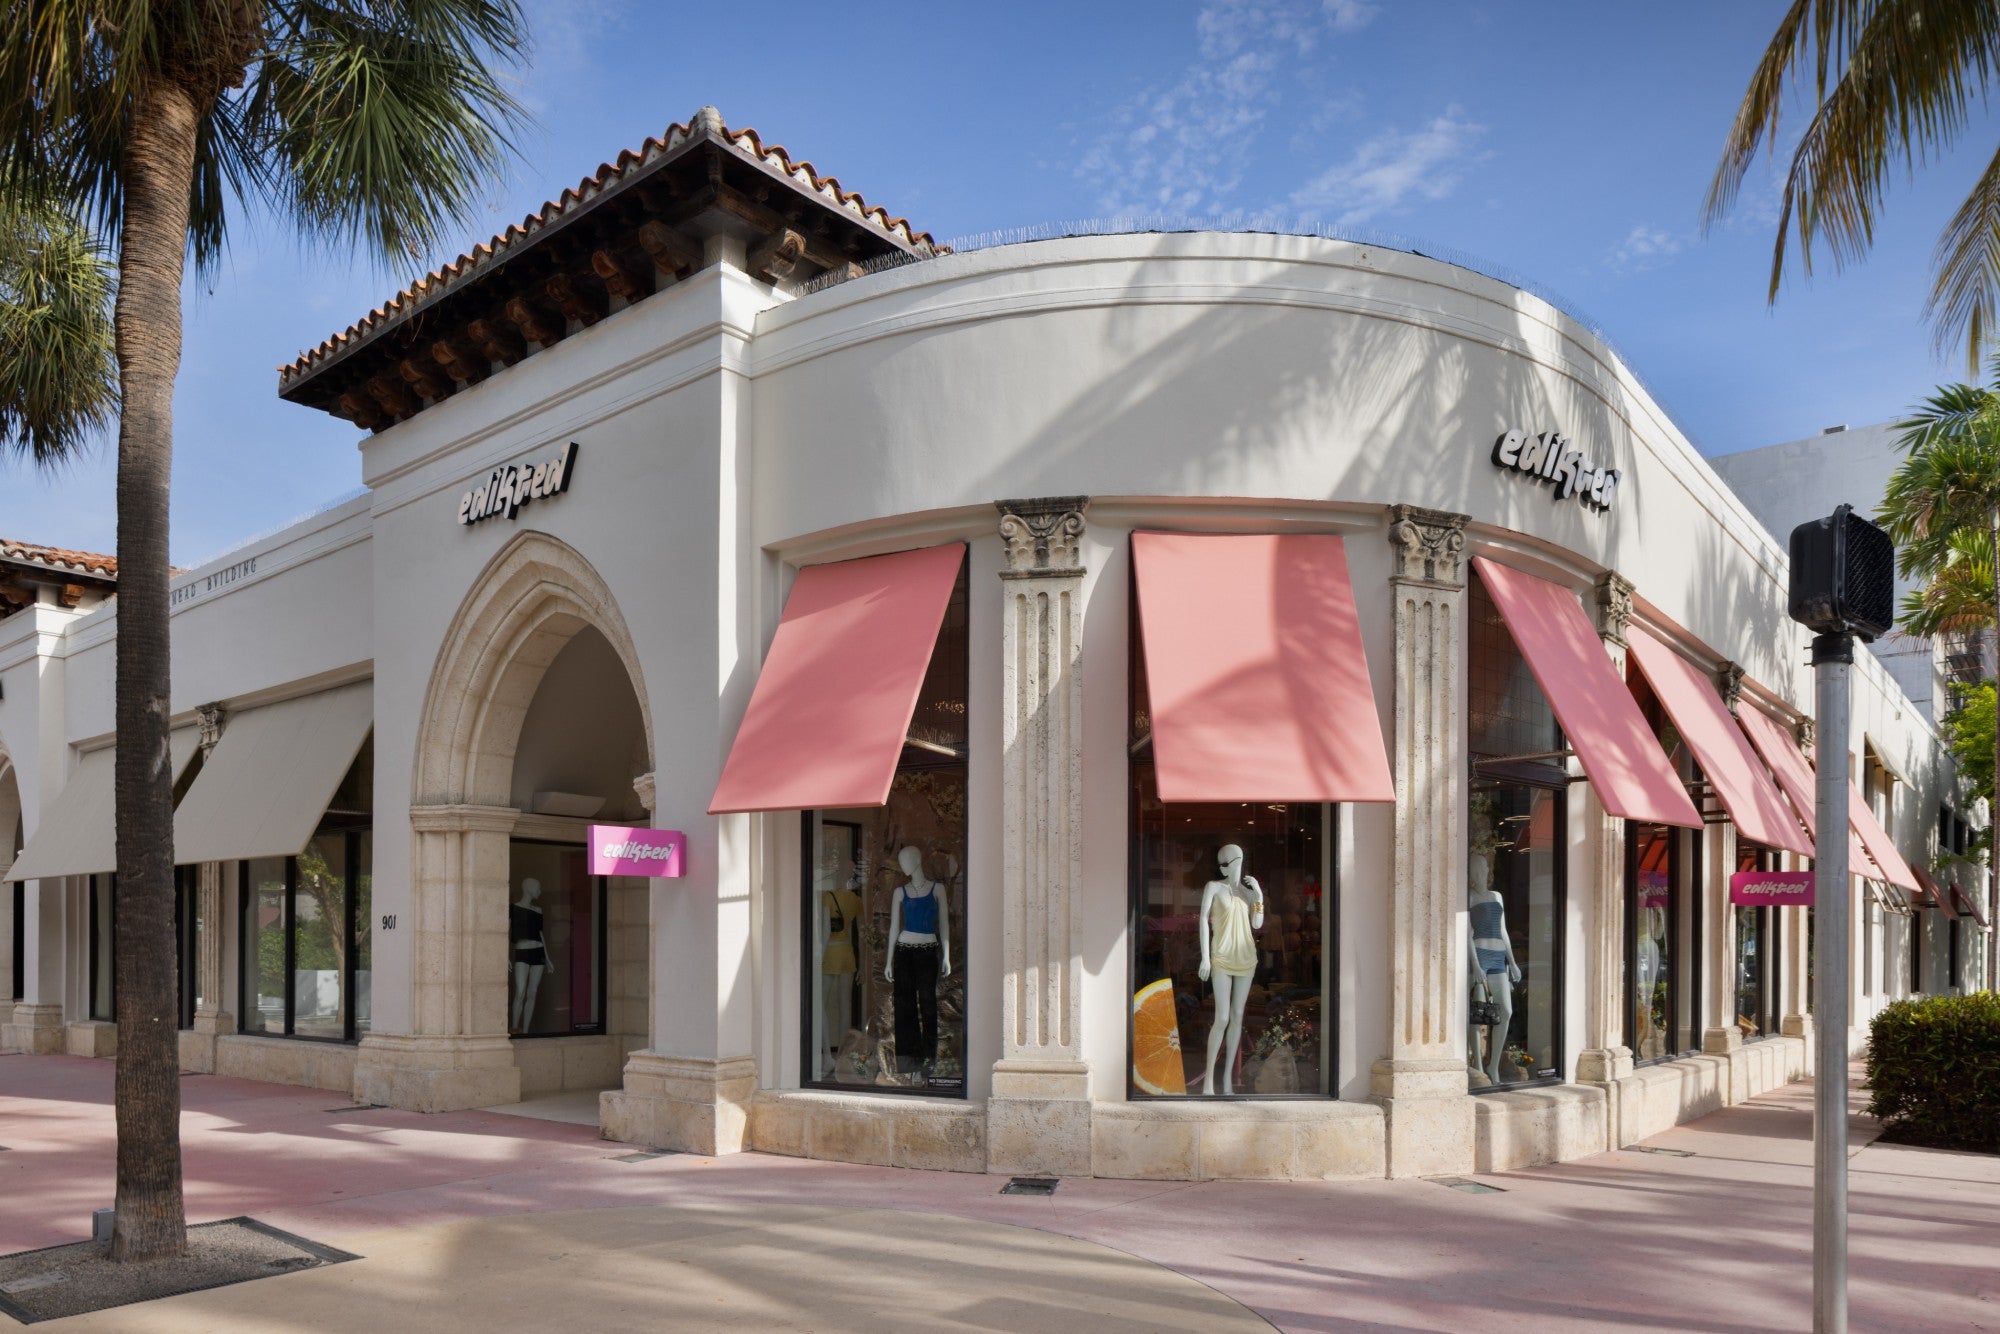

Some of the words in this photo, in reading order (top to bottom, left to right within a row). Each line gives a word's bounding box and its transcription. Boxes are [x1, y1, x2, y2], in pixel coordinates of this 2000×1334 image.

[1493, 428, 1622, 509] edikted
[458, 442, 578, 525] edikted
[603, 840, 674, 863] edikted
[1742, 881, 1810, 896] edikted
[382, 914, 397, 930] 901
